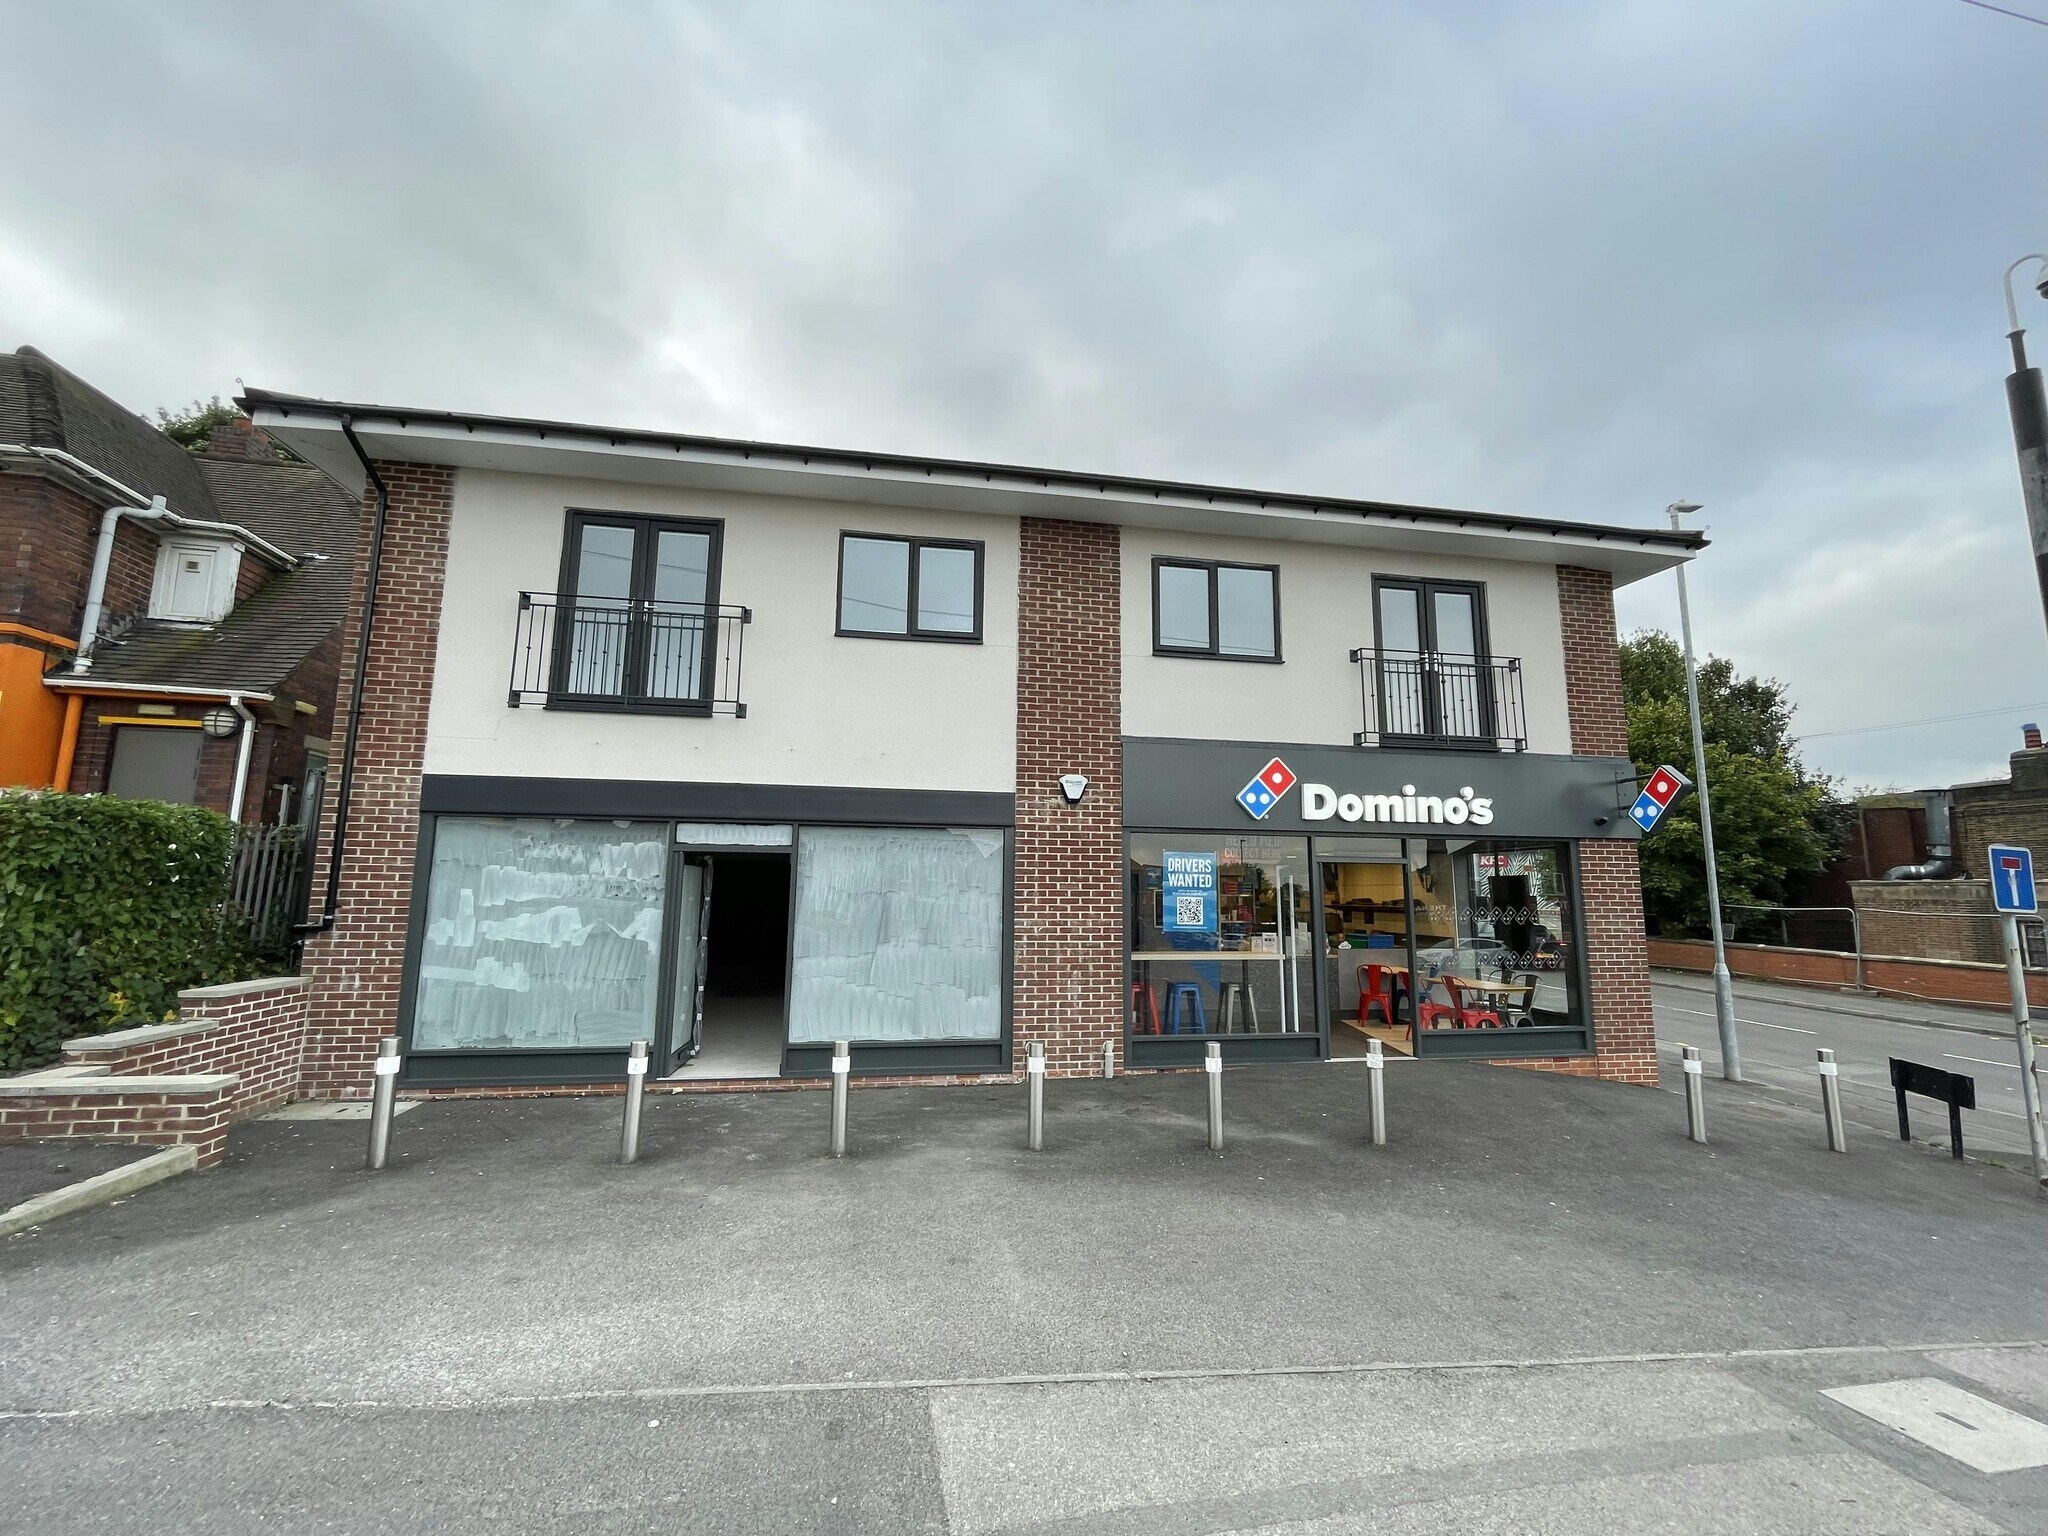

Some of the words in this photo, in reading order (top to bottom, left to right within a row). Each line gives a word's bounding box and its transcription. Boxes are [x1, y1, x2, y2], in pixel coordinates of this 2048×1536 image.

[1301, 783, 1494, 825] Domino's
[1224, 847, 1259, 859] COLECT
[1480, 855, 1505, 865] KFC
[1167, 858, 1212, 873] DRIVERS
[1168, 873, 1212, 888] WANTED
